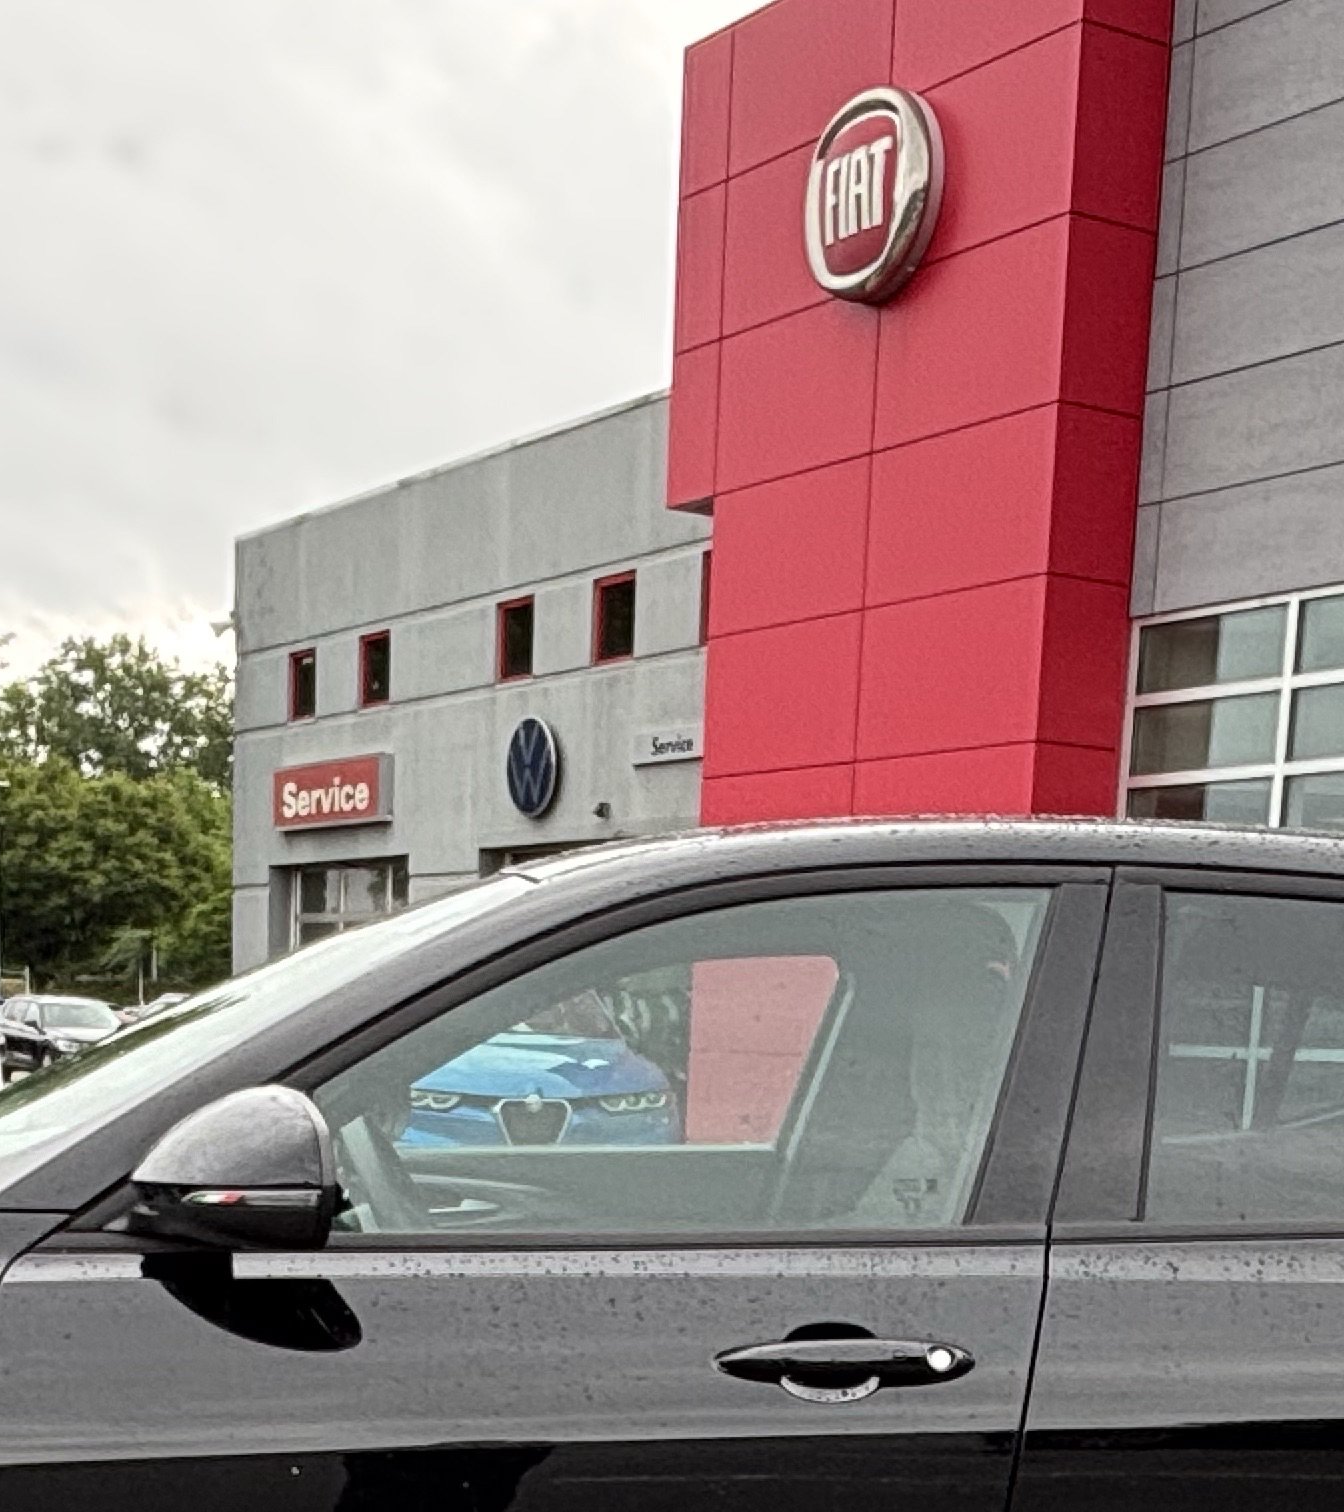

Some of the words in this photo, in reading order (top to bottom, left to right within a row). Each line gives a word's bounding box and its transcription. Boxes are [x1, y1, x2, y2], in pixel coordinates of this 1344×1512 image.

[824, 135, 894, 246] FIAT
[651, 732, 693, 756] Service
[282, 776, 370, 818] Service
